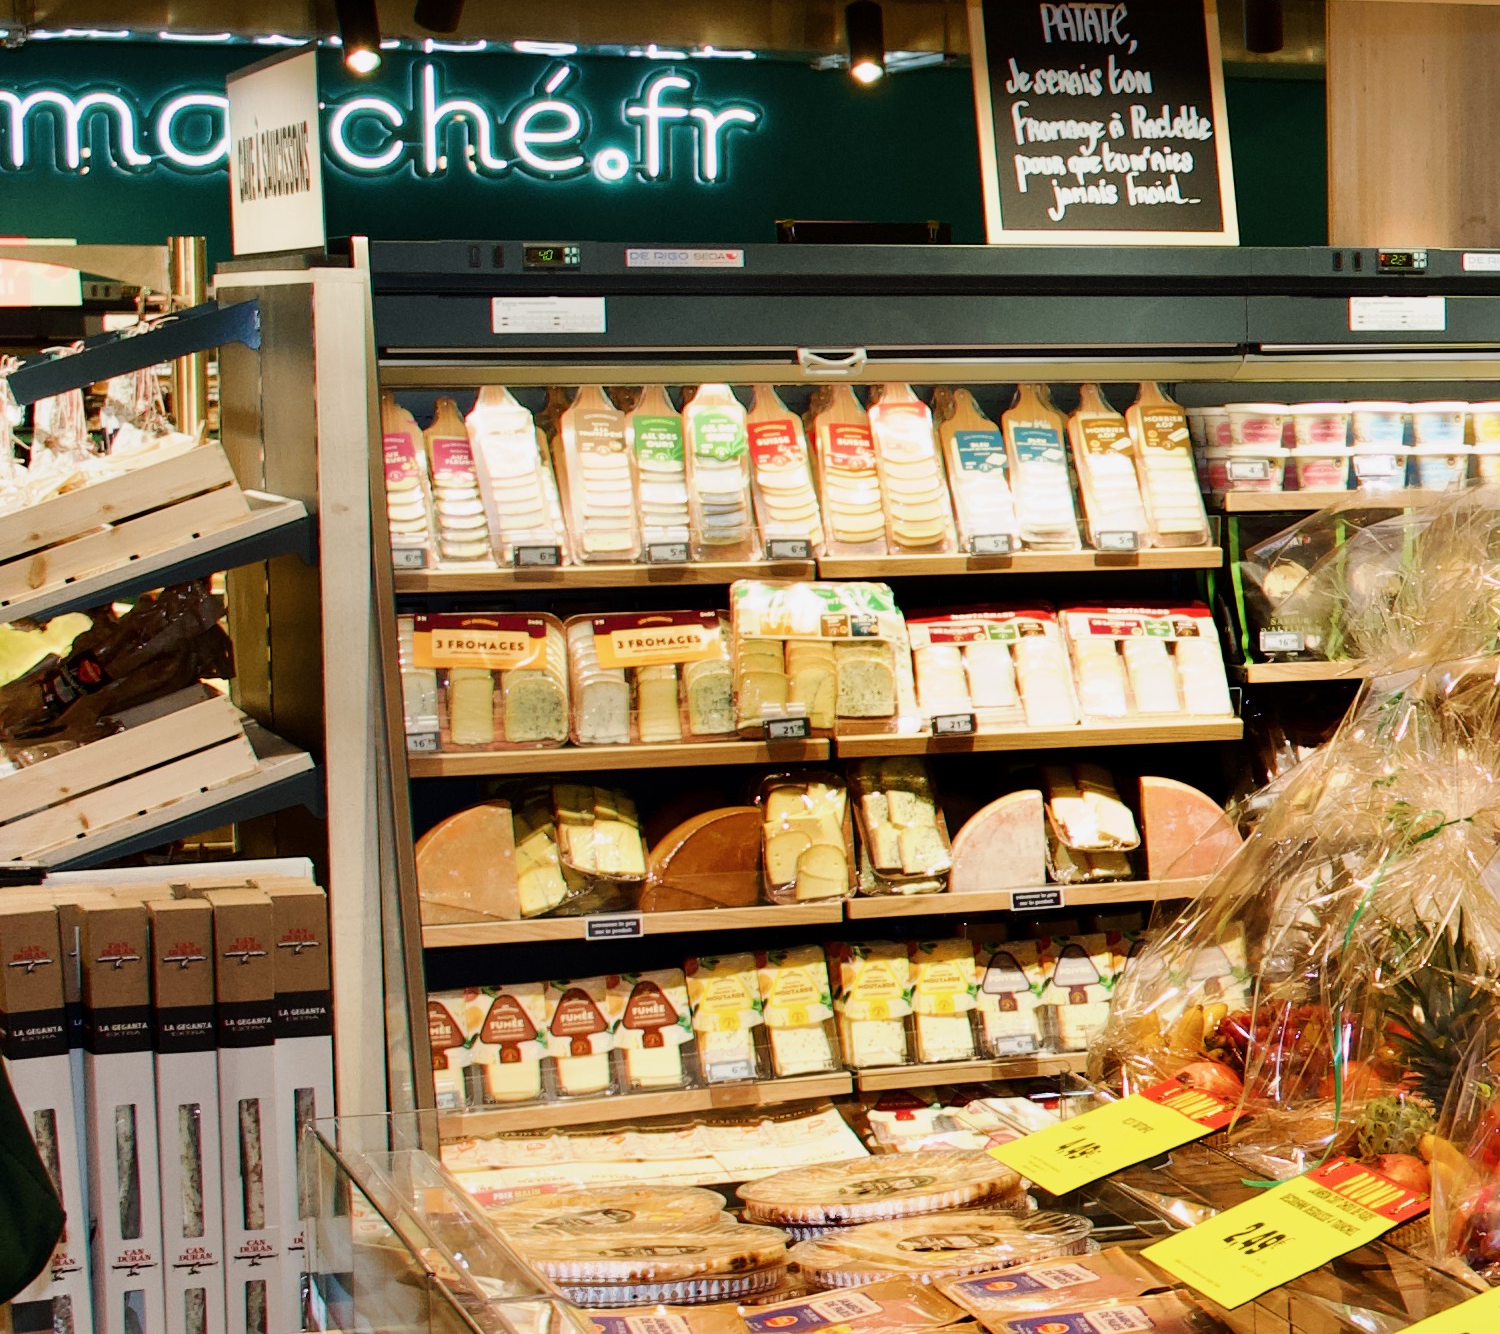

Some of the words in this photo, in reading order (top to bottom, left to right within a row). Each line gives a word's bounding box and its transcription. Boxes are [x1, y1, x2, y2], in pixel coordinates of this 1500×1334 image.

[0, 63, 762, 183] maché.fr
[447, 639, 526, 652] FROMAGES
[627, 634, 702, 648] FROMAGES
[278, 1010, 290, 1018] LA
[13, 1028, 24, 1037] LA
[164, 1025, 175, 1033] LA
[1337, 1172, 1404, 1210] PROMO
